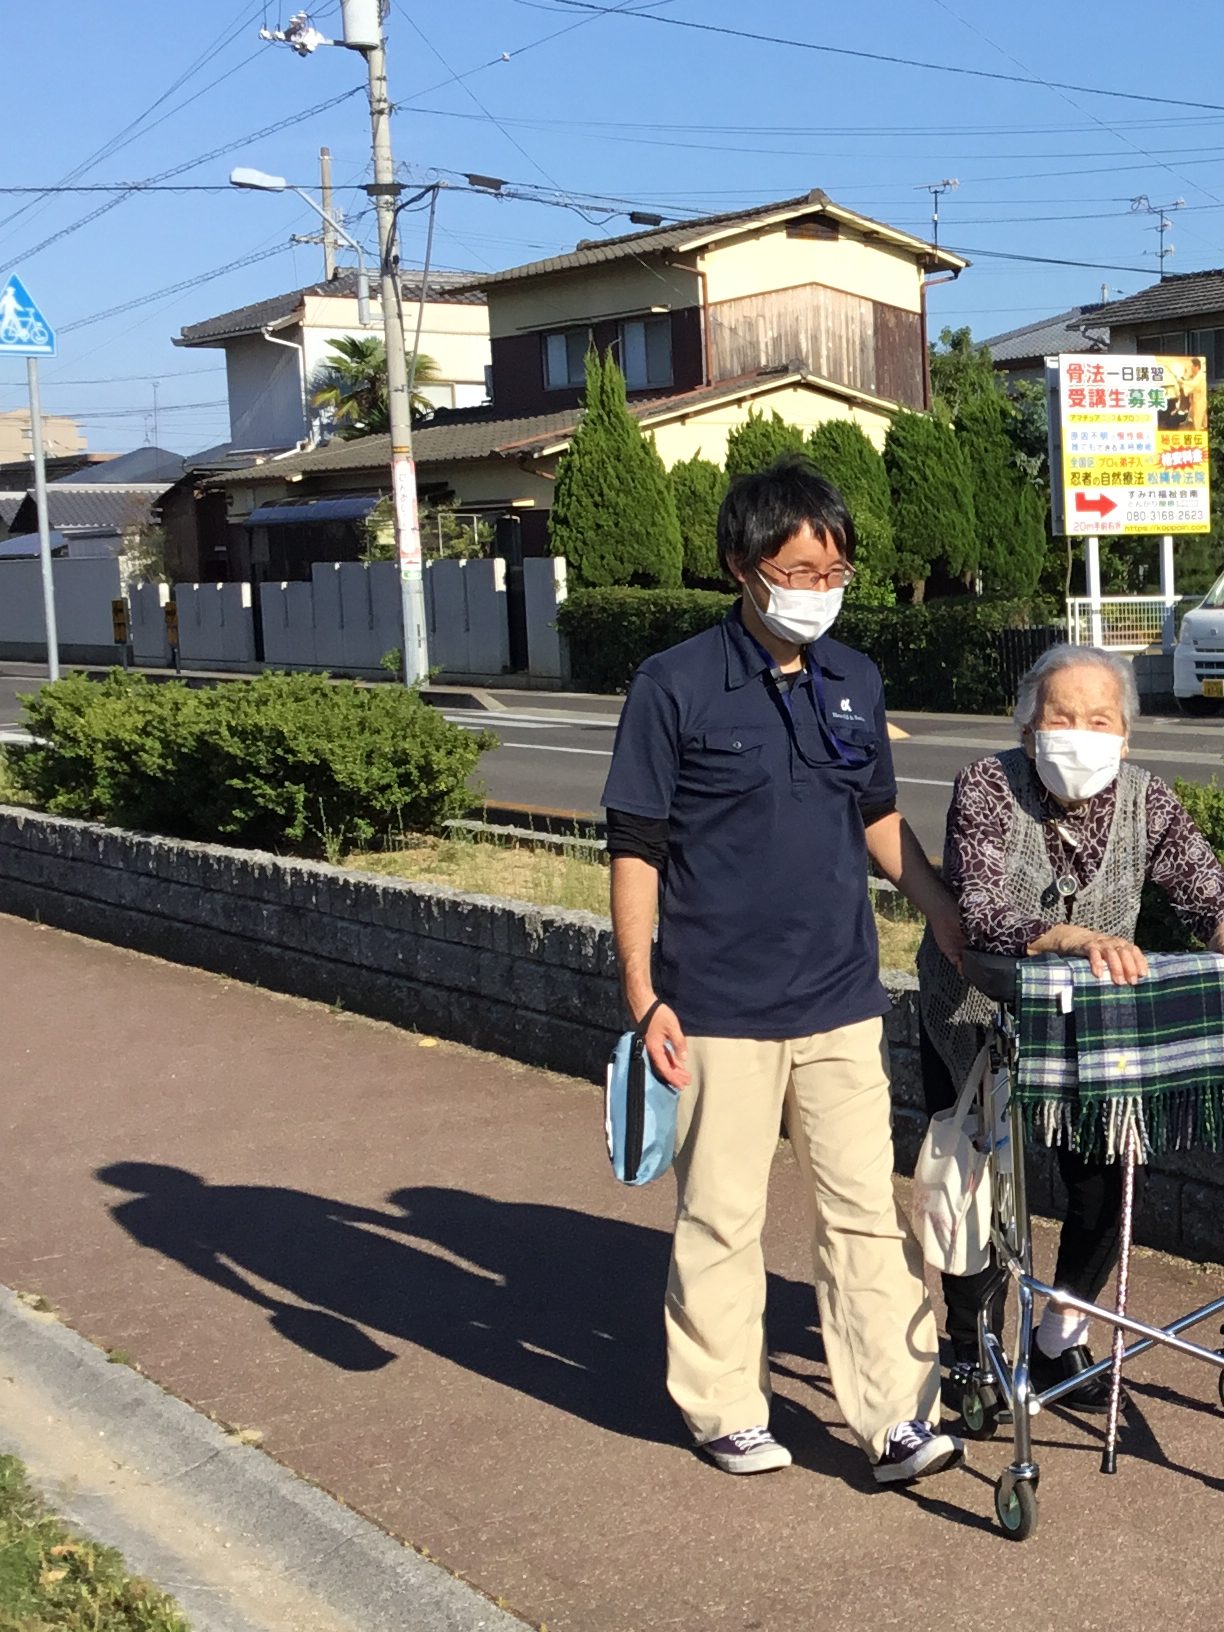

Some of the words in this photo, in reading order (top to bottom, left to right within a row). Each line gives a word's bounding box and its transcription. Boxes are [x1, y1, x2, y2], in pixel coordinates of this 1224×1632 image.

[1066, 363, 1164, 384] 骨法一日講習
[1067, 387, 1166, 409] 受講生募集
[1070, 472, 1144, 487] 忍者の自然療法
